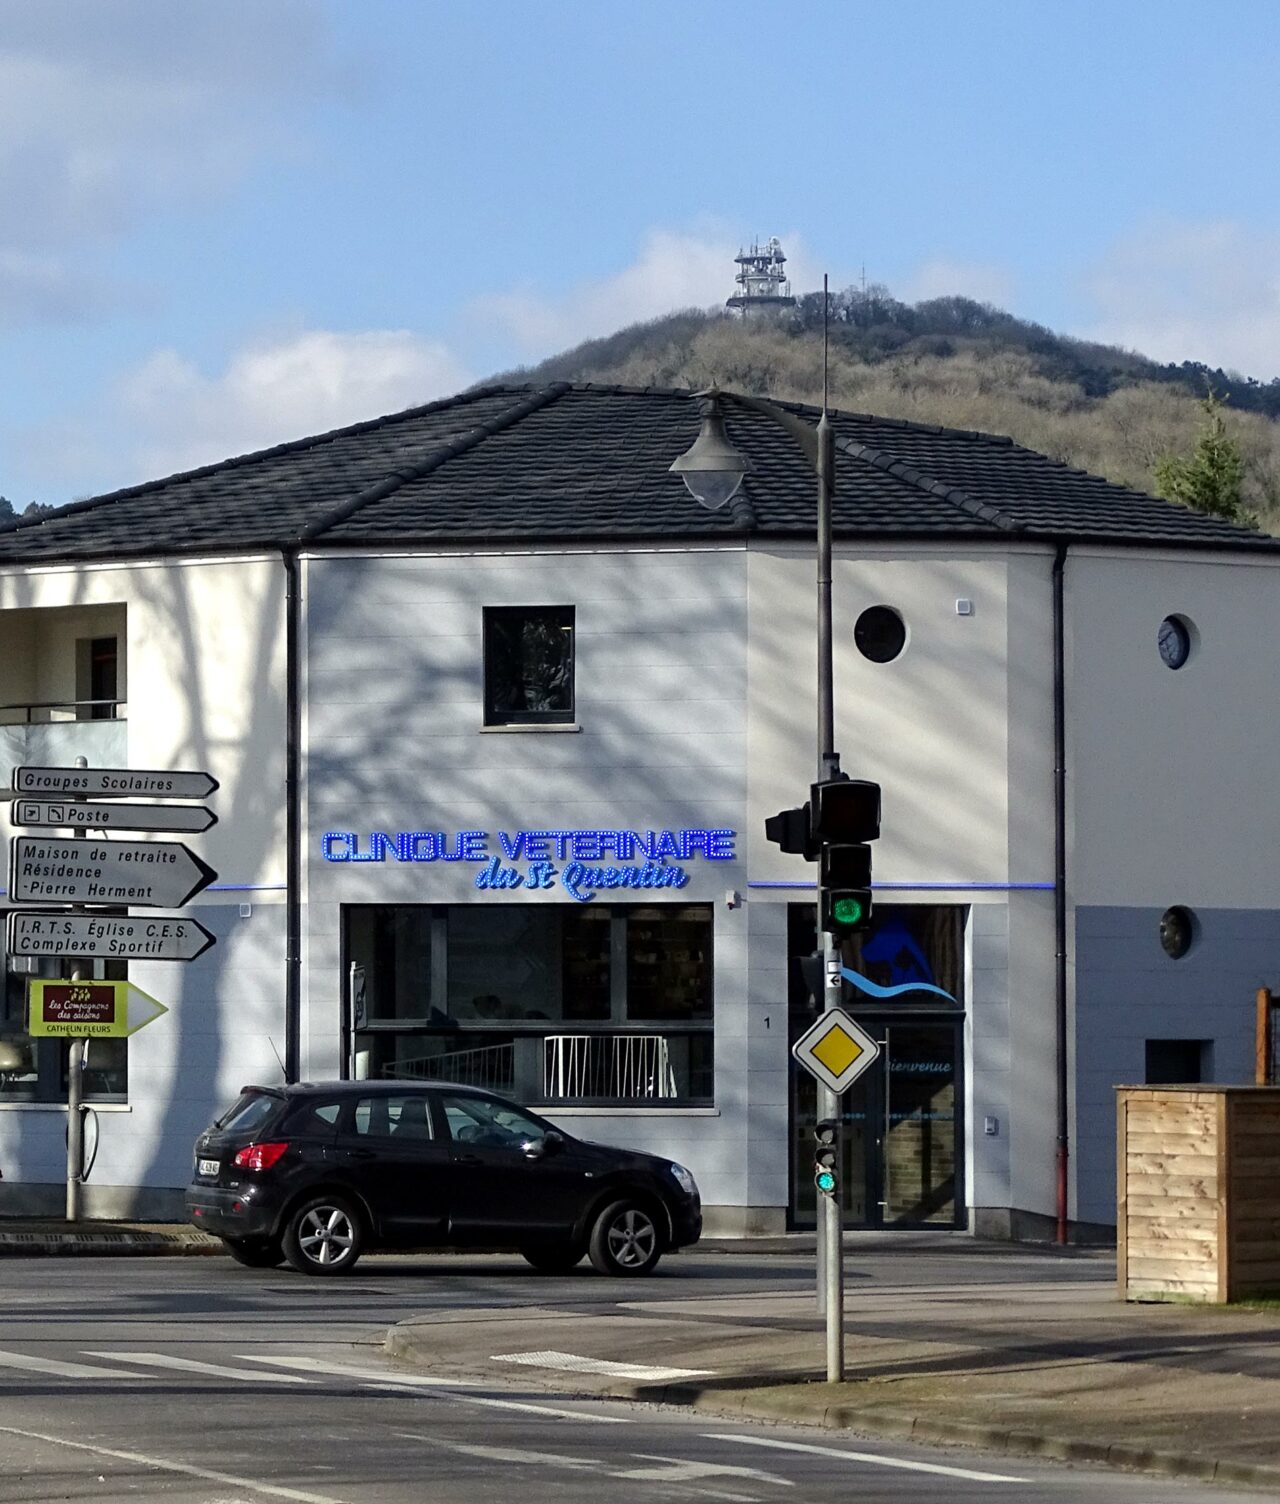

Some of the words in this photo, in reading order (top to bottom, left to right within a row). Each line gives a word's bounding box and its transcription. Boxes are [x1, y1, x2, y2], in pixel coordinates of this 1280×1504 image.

[24, 773, 89, 788] Groupes
[100, 776, 174, 791] Scolaires
[67, 808, 110, 822] Poste
[323, 832, 490, 862] CLINIQUE
[497, 830, 737, 861] VETERINAIRE
[23, 845, 79, 860] Maison
[89, 848, 107, 861] de
[118, 850, 177, 863] retraite
[23, 863, 102, 878] Résidence
[475, 855, 520, 889] du
[524, 861, 556, 889] St
[561, 855, 688, 902] Quentin
[87, 884, 152, 898] Herment
[20, 920, 76, 935] I.R.T.S.
[87, 918, 134, 938] Église
[146, 924, 188, 938] C.E.S.
[20, 937, 96, 952] Complexe
[108, 940, 164, 955] Sportif
[63, 1000, 109, 1013] Compagnons
[72, 1012, 101, 1020] saisons
[763, 1016, 771, 1030] 1
[46, 1024, 82, 1033] CATHELIN
[83, 1025, 111, 1034] FLEURS
